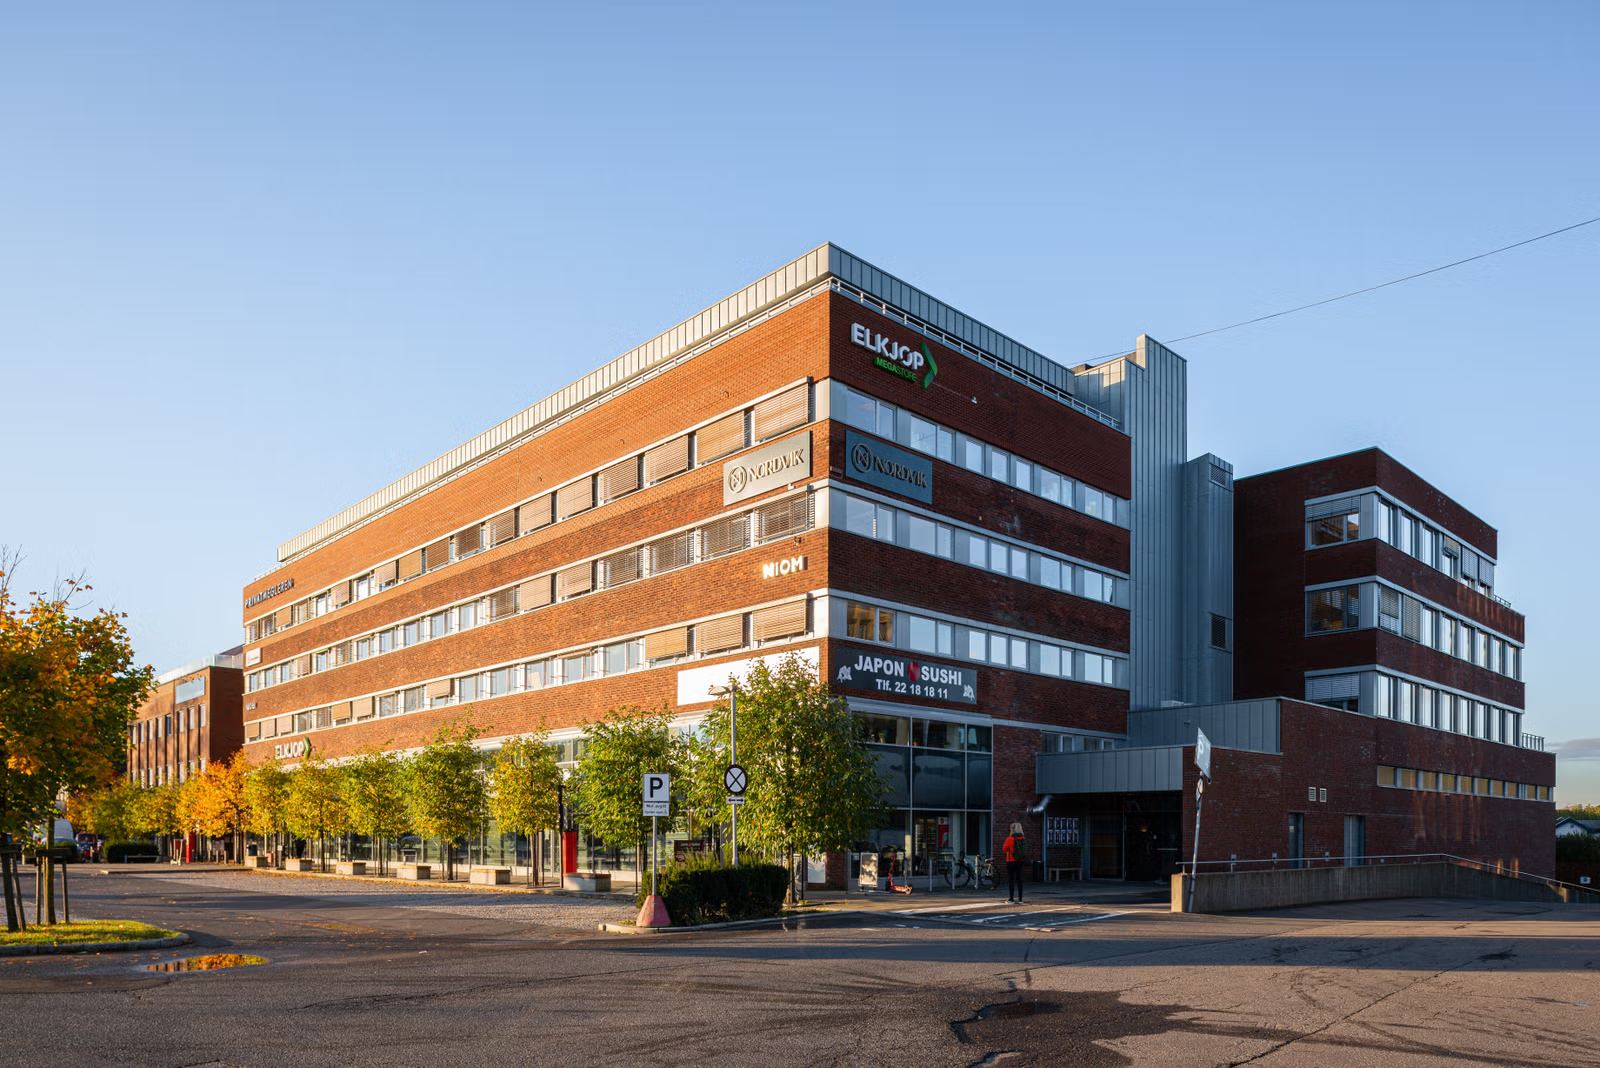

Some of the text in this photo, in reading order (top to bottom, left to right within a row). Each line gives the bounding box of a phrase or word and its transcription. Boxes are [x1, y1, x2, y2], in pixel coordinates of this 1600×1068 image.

[747, 448, 804, 482] NORDVIK
[873, 455, 928, 489] NORDVIK
[762, 555, 805, 580] NIOM
[854, 655, 962, 686] JAPON SUSHI
[875, 678, 948, 699] Tlf. 22 18 18 11
[650, 777, 663, 798] P
